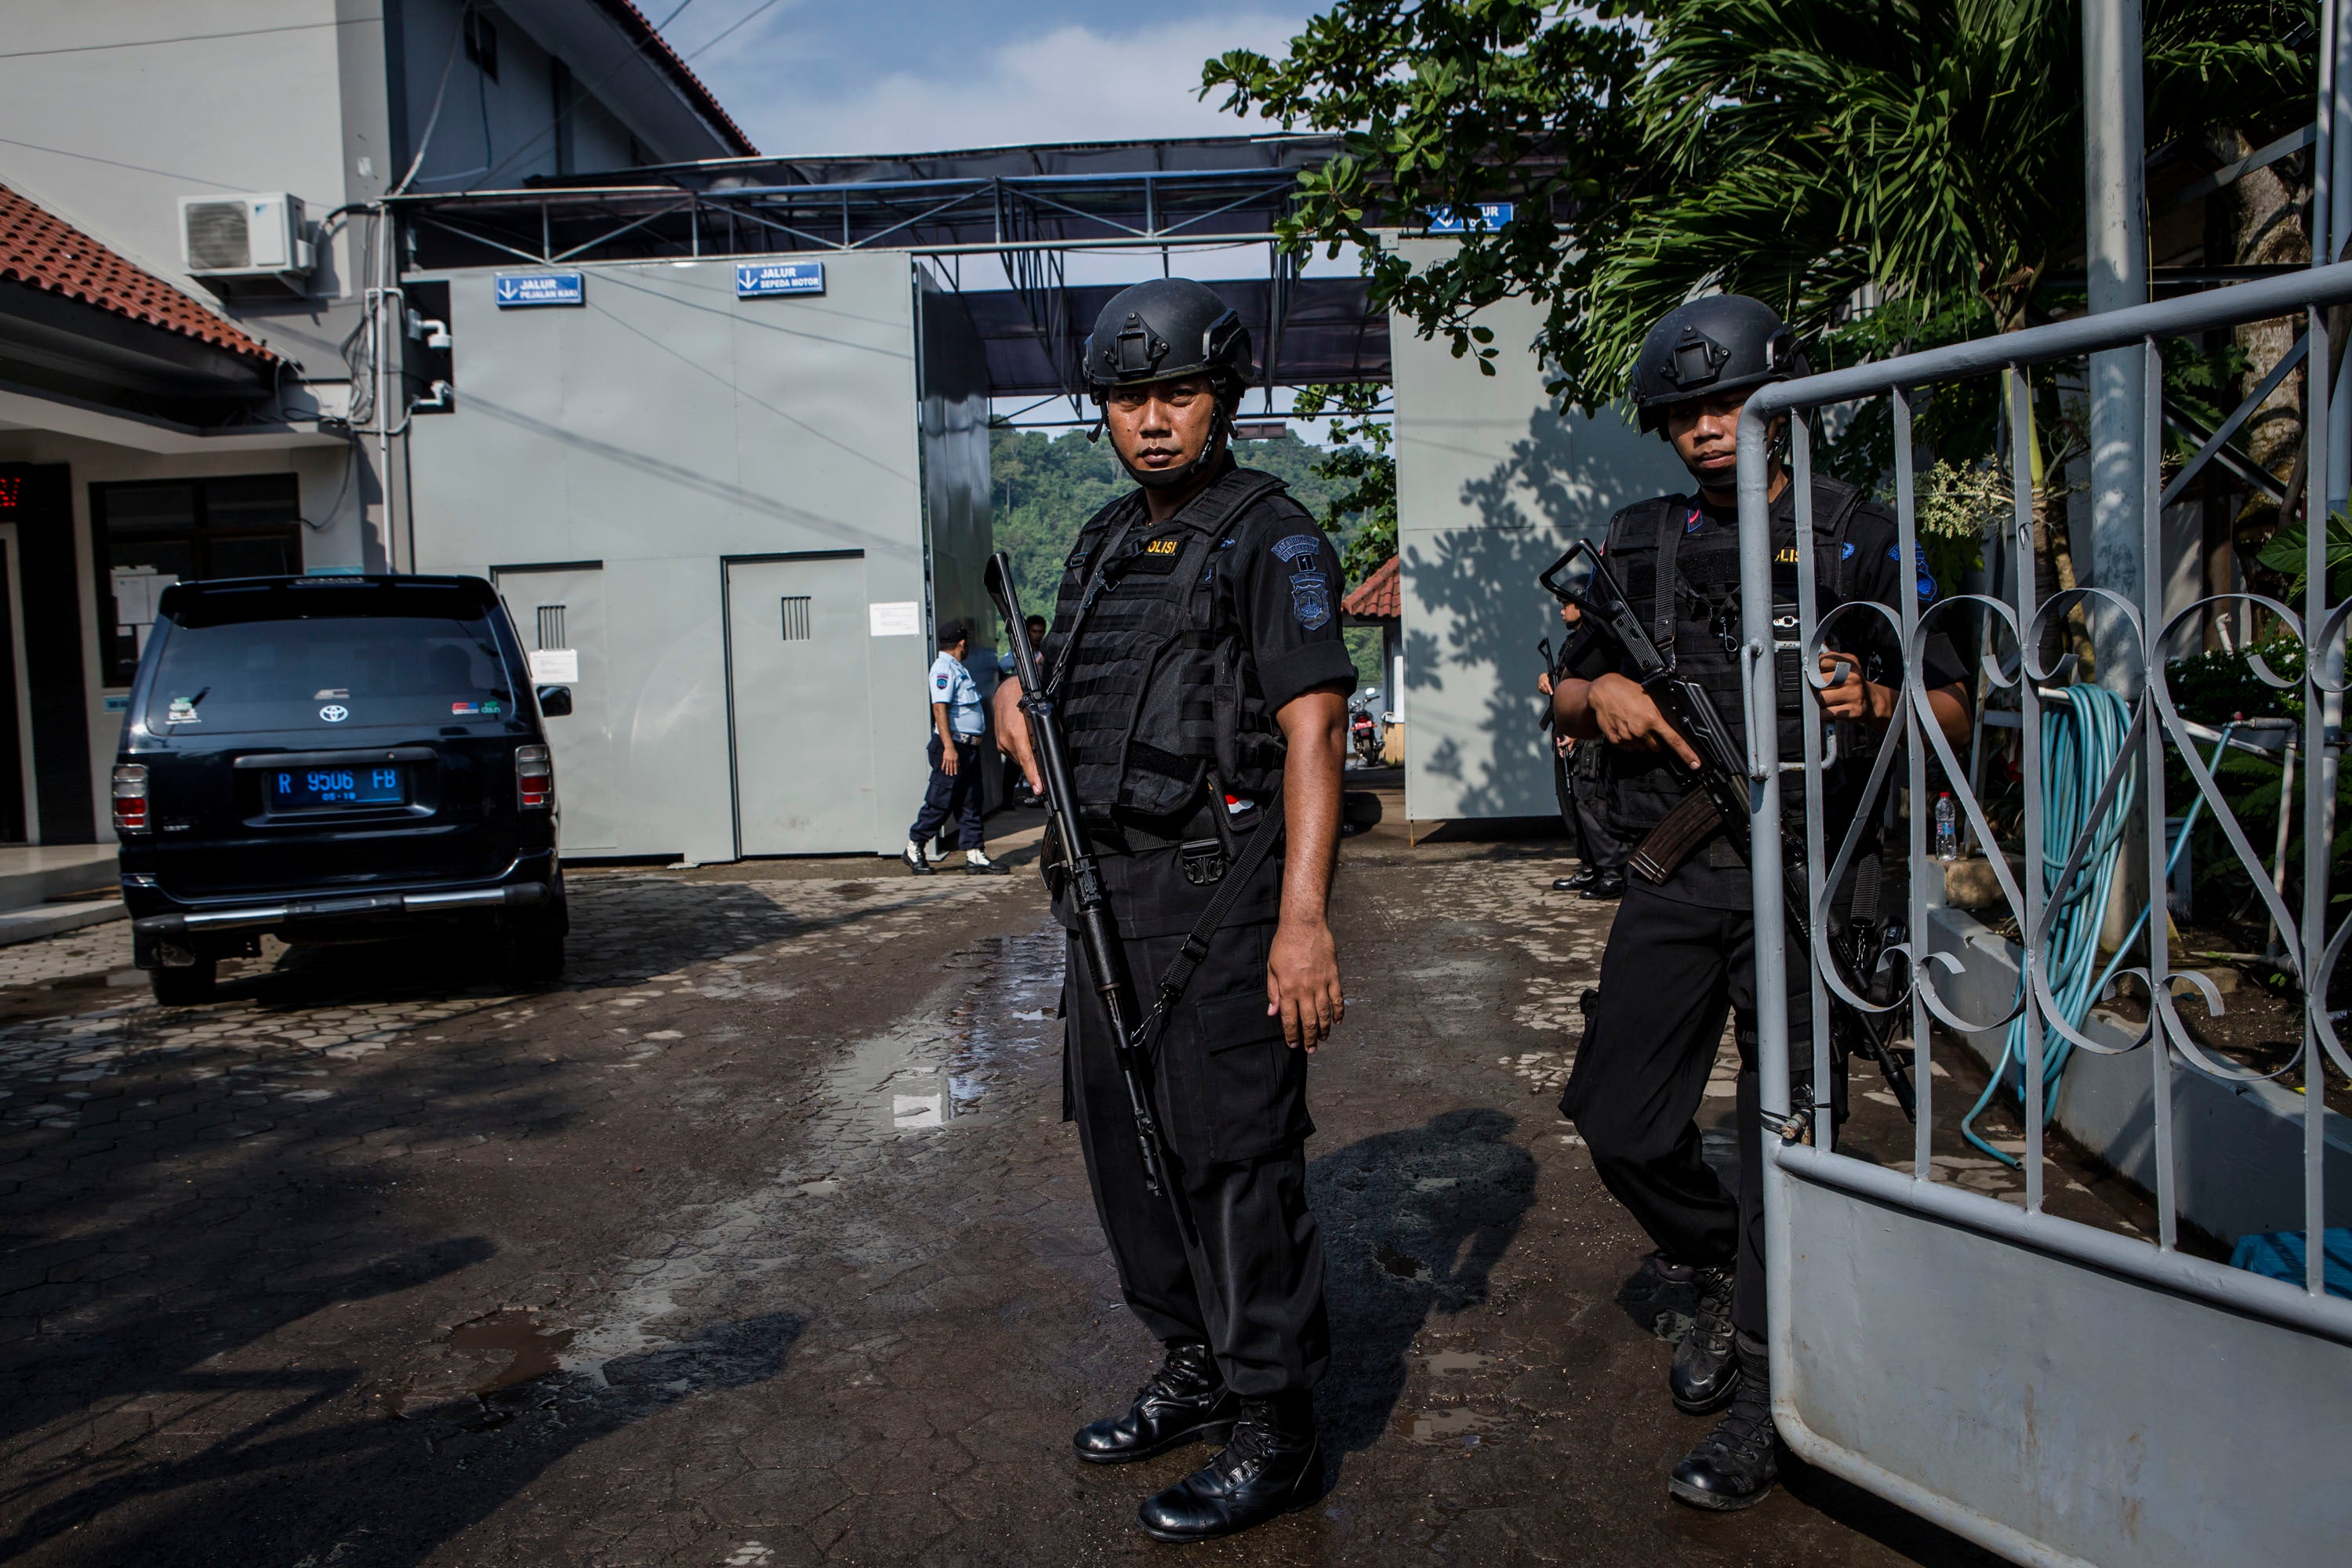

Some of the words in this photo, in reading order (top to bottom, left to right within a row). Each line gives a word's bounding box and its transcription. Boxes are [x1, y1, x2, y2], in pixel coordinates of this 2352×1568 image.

[760, 267, 797, 278] JALUR
[520, 278, 557, 290] JALUR
[760, 278, 791, 289] SEPEDA
[791, 277, 819, 287] MOTOR
[1147, 540, 1177, 554] OLISI
[278, 773, 292, 793] R
[307, 769, 354, 791] 9506
